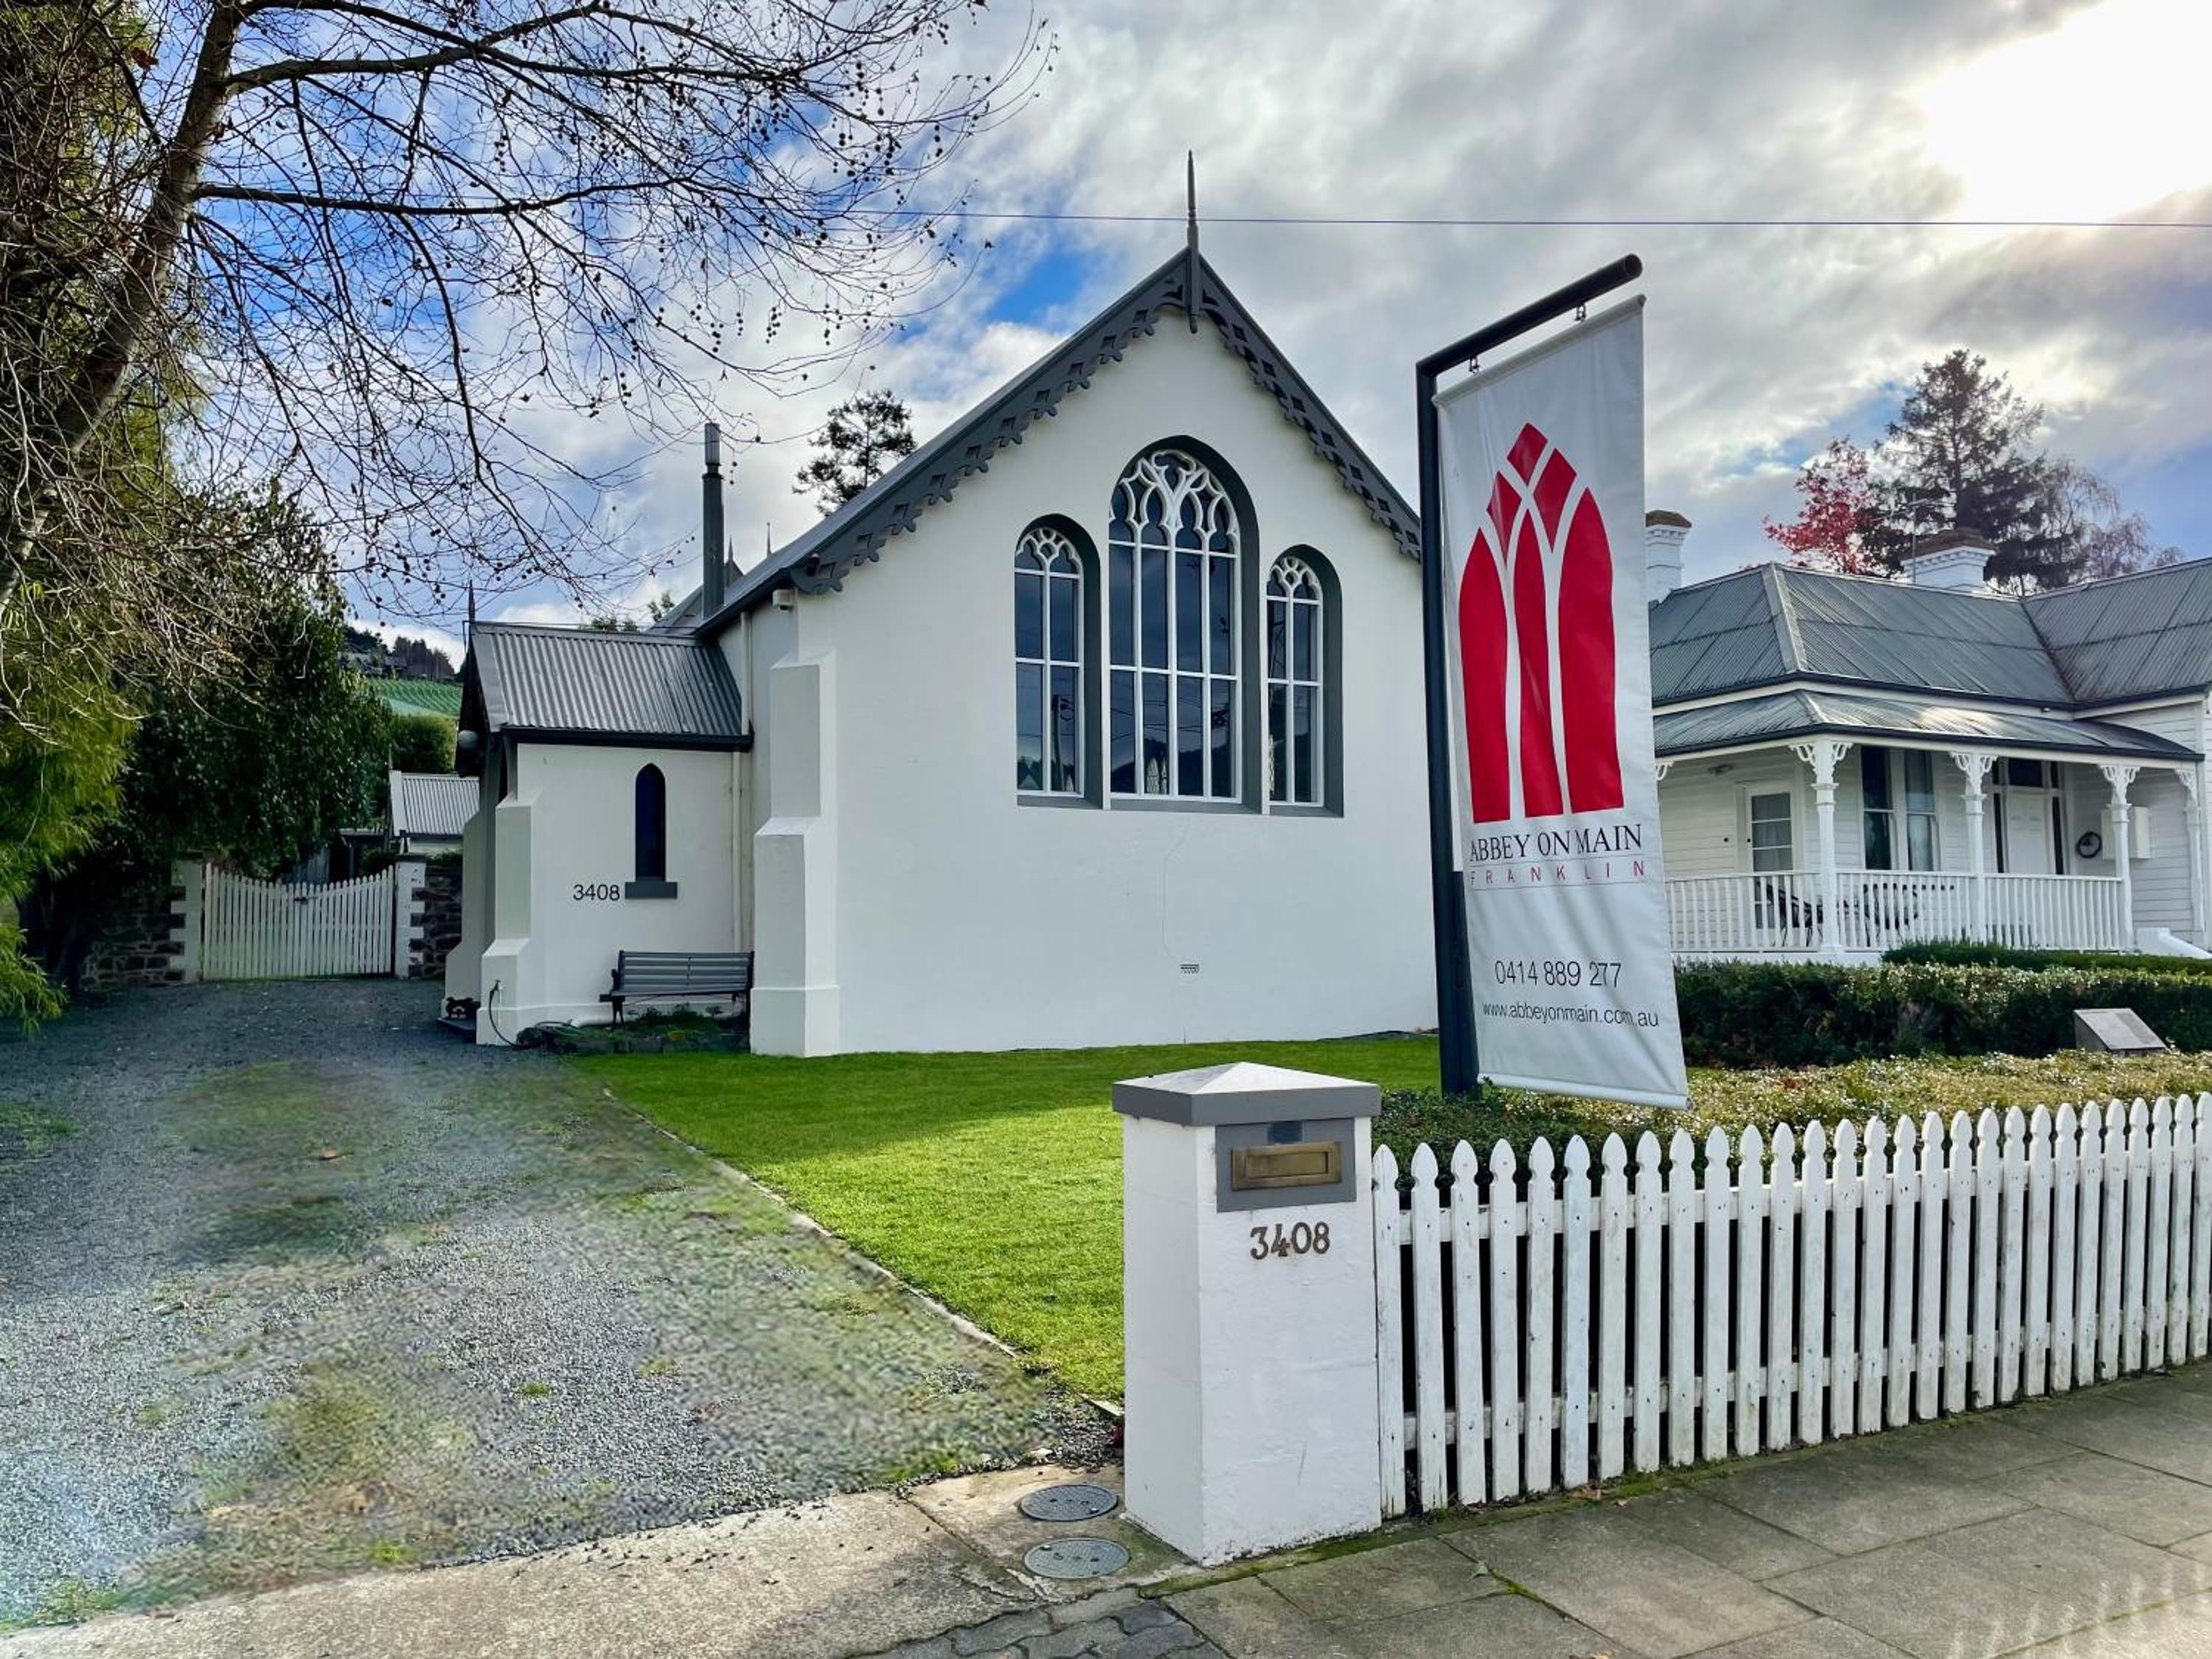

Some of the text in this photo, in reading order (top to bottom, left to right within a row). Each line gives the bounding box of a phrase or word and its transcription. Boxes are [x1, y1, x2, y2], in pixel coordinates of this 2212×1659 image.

[1470, 824, 1642, 862] ABBEY ON MAIN
[1470, 860, 1644, 885] FRANKLIN
[573, 883, 620, 901] 3408
[1494, 960, 1622, 988] 0414 889 277
[1482, 1001, 1659, 1027] www.abbeyonmain.com.au
[1250, 1222, 1331, 1260] 3408
